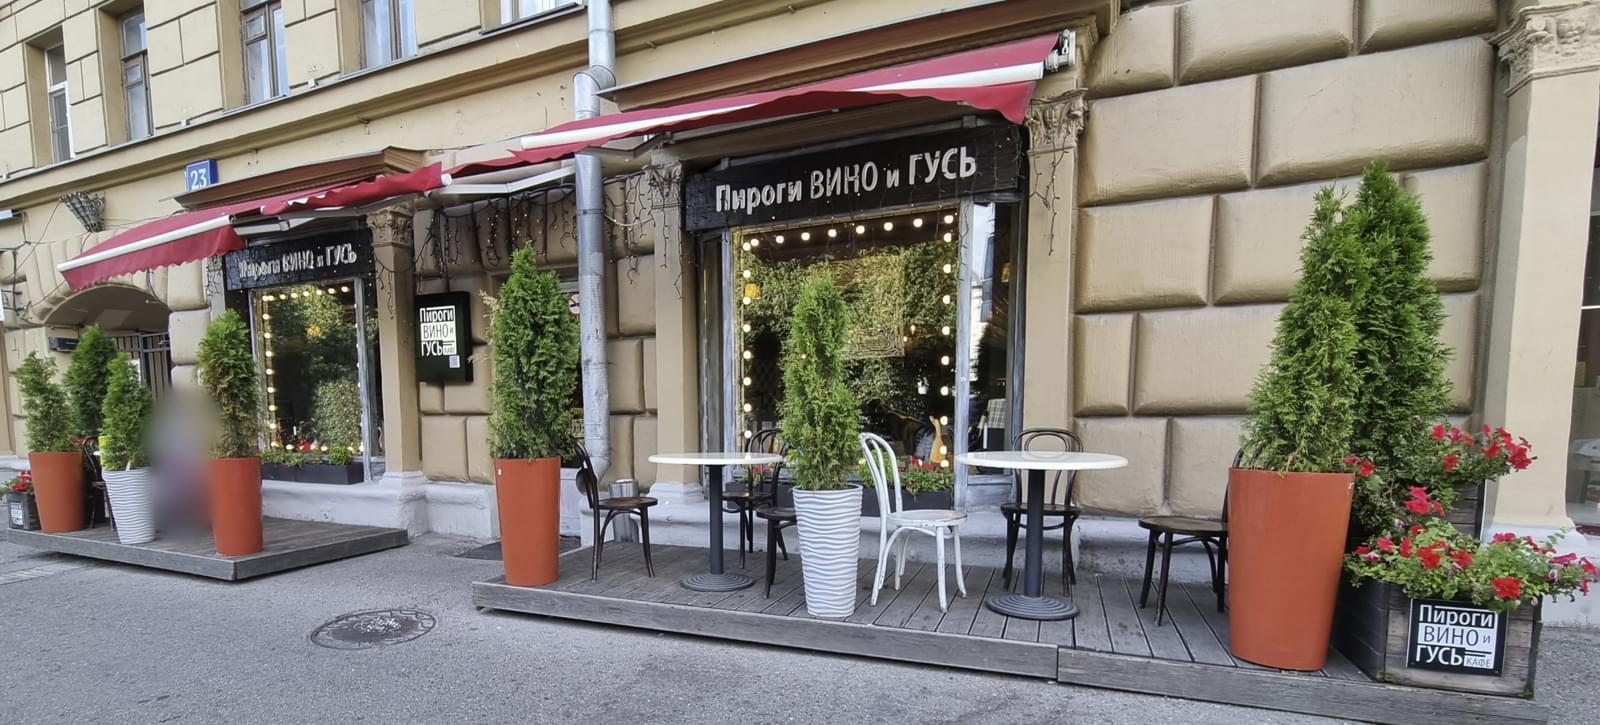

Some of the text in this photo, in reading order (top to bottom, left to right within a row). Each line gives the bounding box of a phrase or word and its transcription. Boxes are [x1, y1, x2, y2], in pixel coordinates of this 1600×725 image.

[190, 168, 207, 190] 23
[716, 147, 977, 215] Пироги ВИНО и ГУСЬ
[282, 250, 314, 272] ВИНО
[325, 243, 357, 267] ГУСЬ
[420, 308, 453, 322] Пироги
[423, 324, 448, 339] ВИНО
[421, 341, 443, 356] ГУСЬ
[1419, 605, 1493, 627] Пироги
[1424, 625, 1490, 646] ВИНО и
[1416, 645, 1491, 667] ГУСЬ КАФЕ
